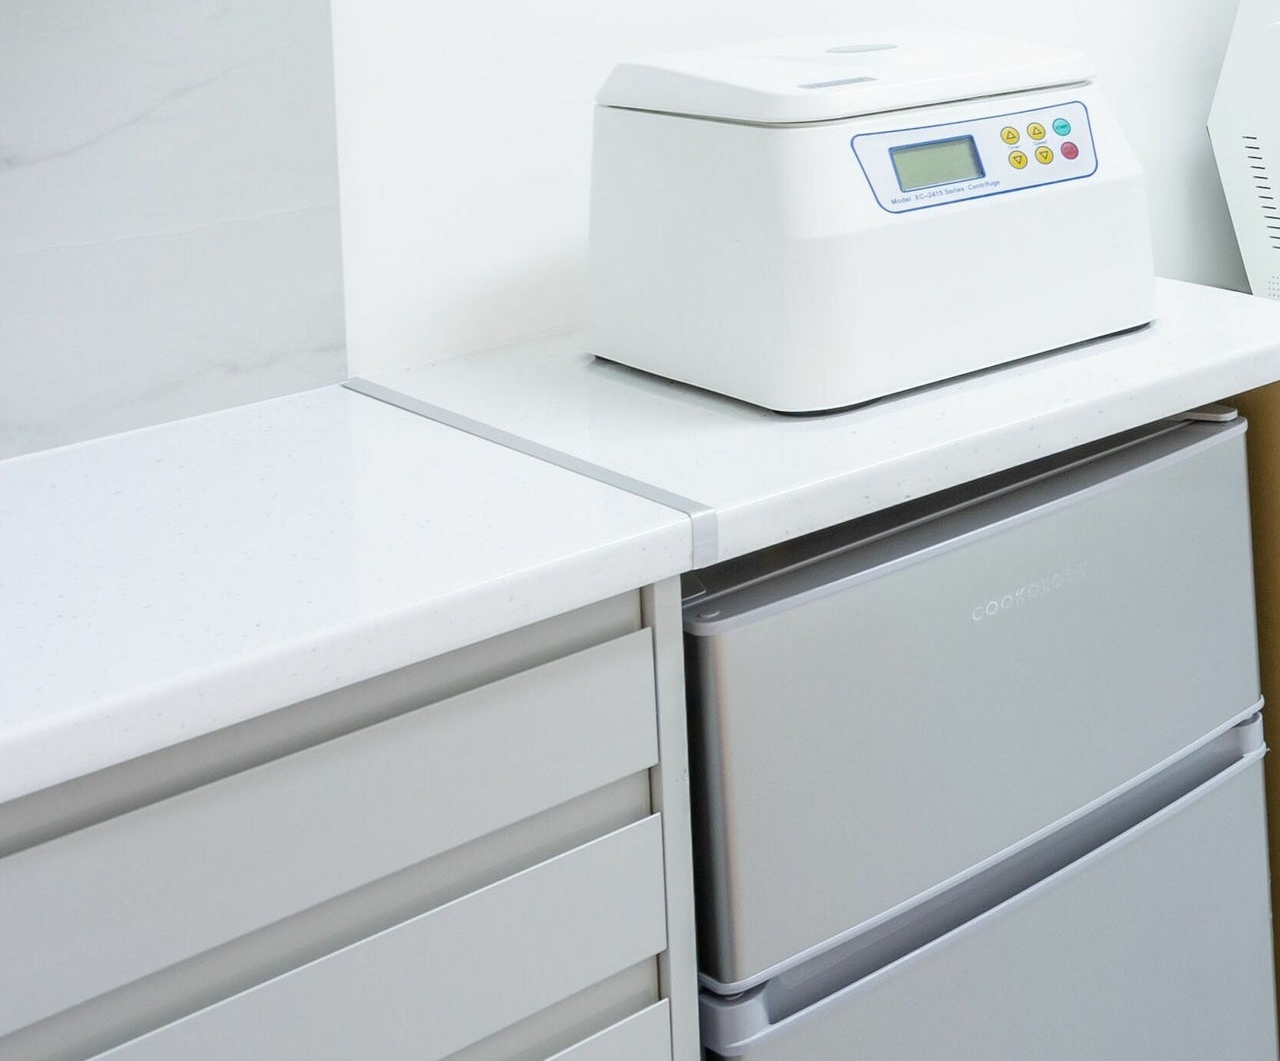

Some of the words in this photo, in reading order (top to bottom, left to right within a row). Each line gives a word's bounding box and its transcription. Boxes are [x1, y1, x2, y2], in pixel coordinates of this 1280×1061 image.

[890, 197, 911, 205] Model
[944, 186, 965, 196] Series
[967, 180, 1000, 191] Centrifuge
